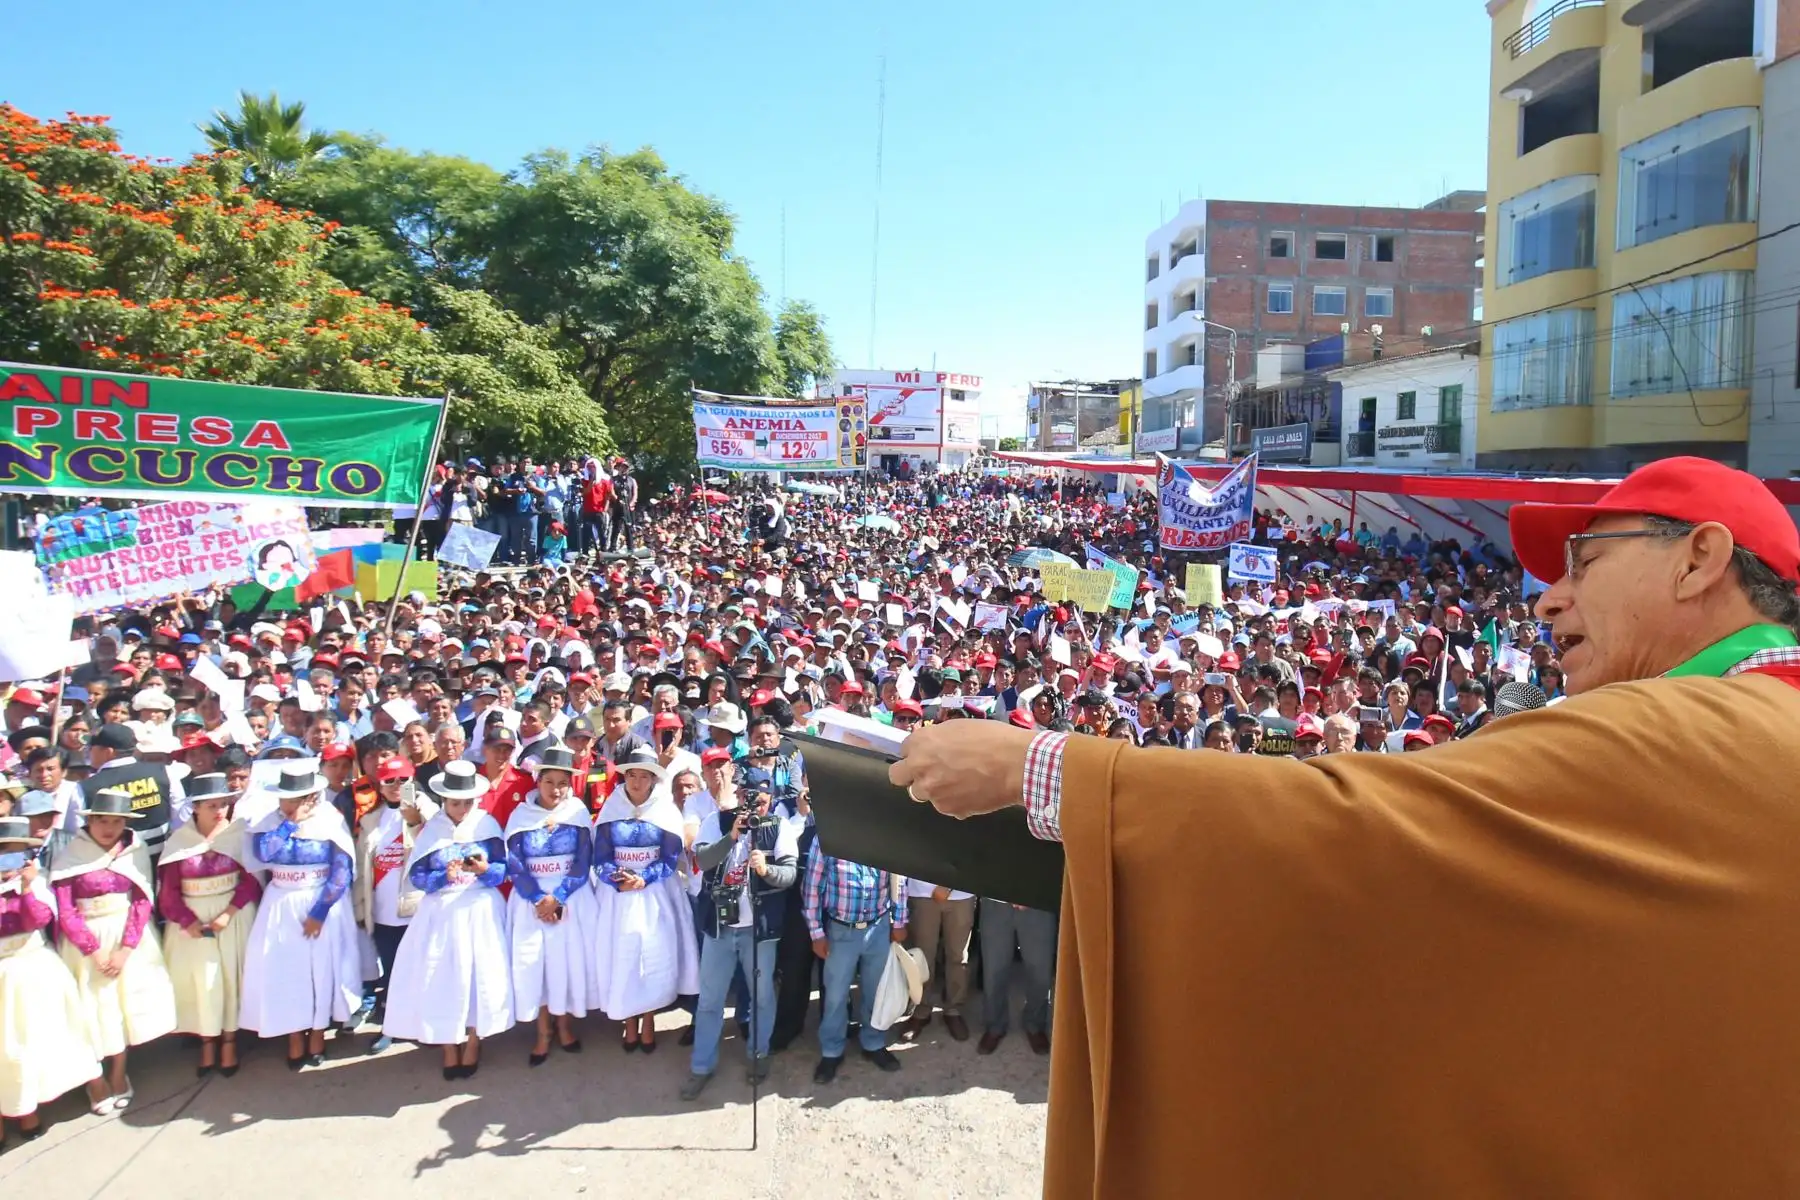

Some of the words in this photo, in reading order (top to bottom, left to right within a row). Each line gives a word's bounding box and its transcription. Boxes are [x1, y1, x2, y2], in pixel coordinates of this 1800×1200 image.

[895, 372, 920, 384] MI
[936, 373, 980, 388] PERU
[822, 409, 835, 417] LA
[13, 406, 292, 450] PRESA
[725, 417, 806, 431] ANEMIA
[711, 440, 743, 456] 65%
[781, 442, 817, 458] 12%
[0, 441, 385, 496] NCUCHO
[137, 519, 194, 545] BIEN
[1161, 521, 1250, 547] RESENTE
[66, 540, 191, 577] NUTRIDOS
[1257, 740, 1296, 752] POLICIA
[528, 862, 561, 873] MANGA
